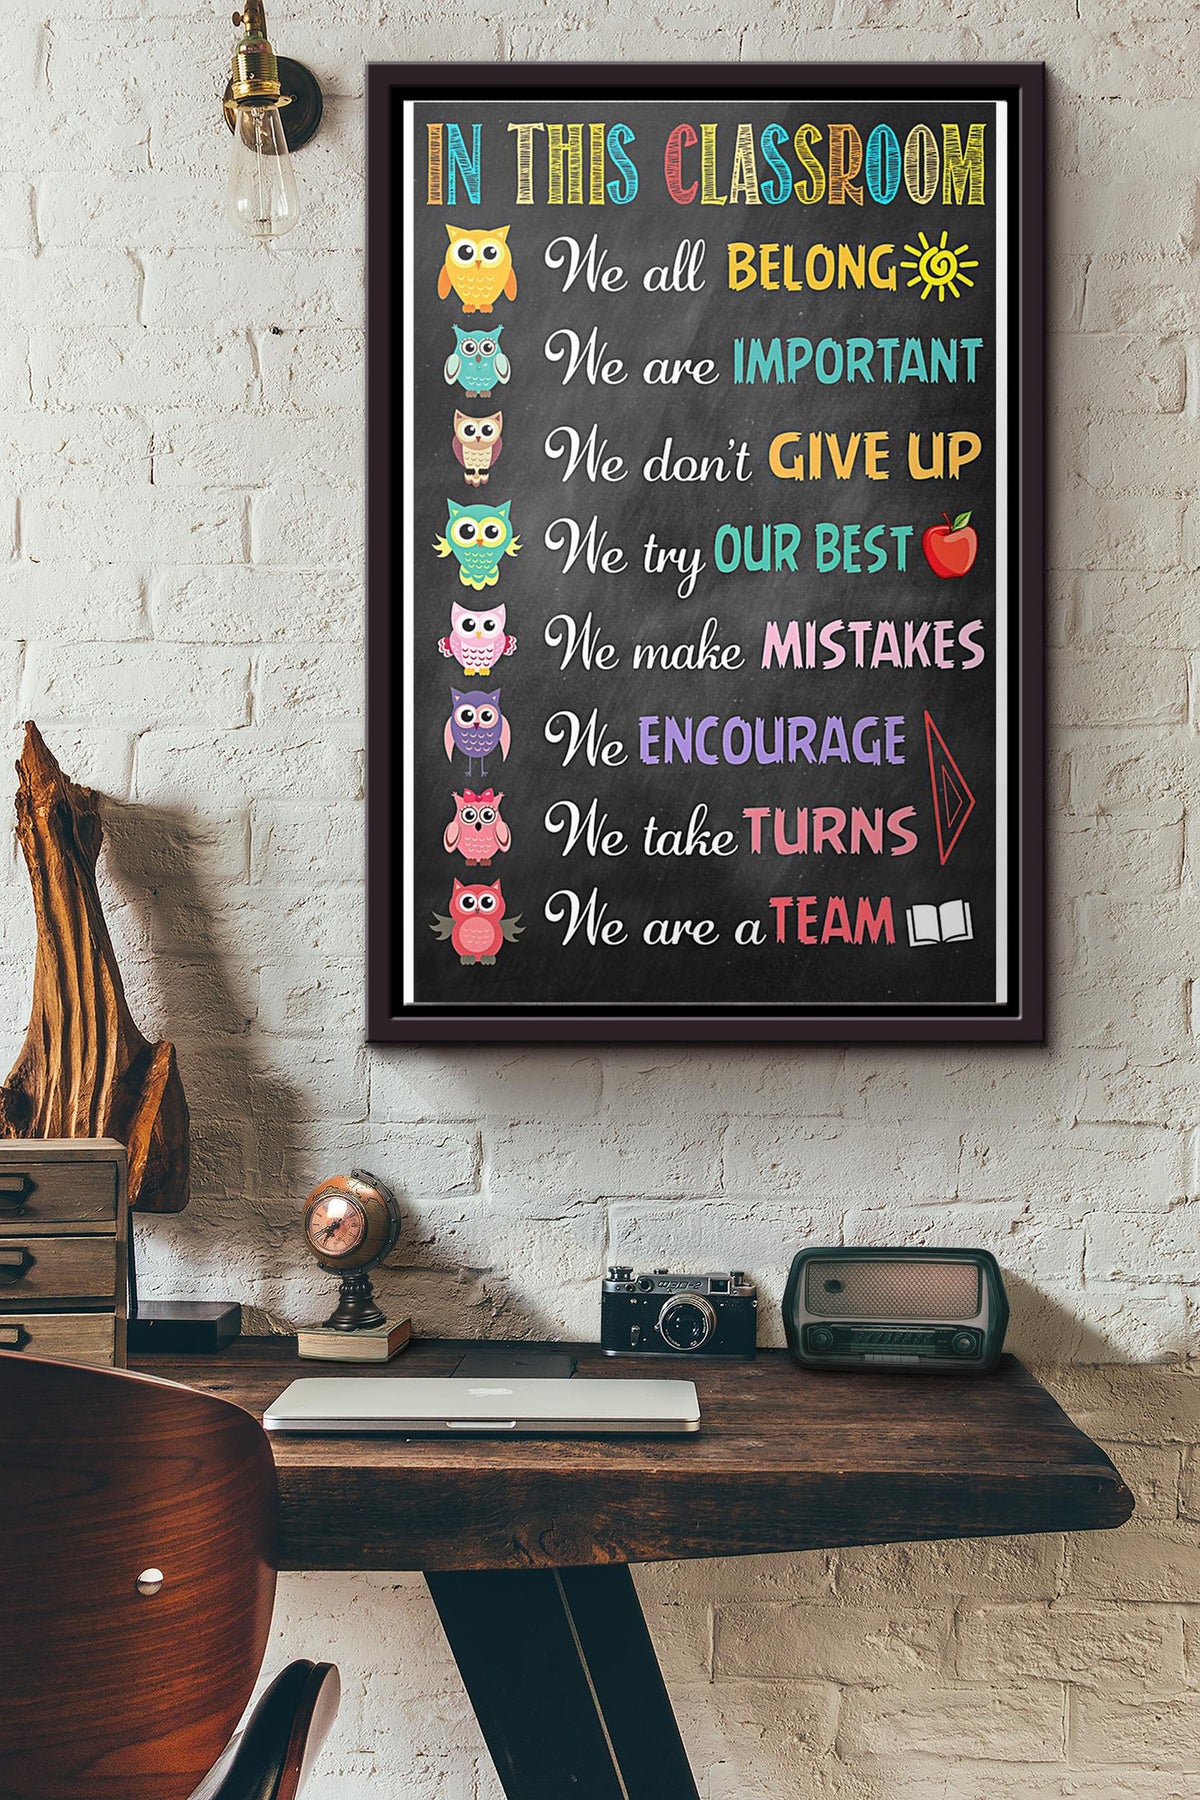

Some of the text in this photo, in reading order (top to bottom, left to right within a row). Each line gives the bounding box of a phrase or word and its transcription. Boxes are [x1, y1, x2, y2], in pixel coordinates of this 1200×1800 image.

[426, 123, 986, 206] IN THIS CLASSROOM
[544, 233, 897, 293] We all BELONG
[544, 326, 984, 386] We are IMPORTANT
[544, 423, 982, 483] We don't GIVE UP
[544, 514, 914, 599] We try OUR BEST
[544, 611, 985, 671] We make MISTAKES
[544, 707, 906, 767] We ENCOURAGE
[544, 797, 918, 857] We take TURNS
[544, 886, 896, 946] We are a TEAM
